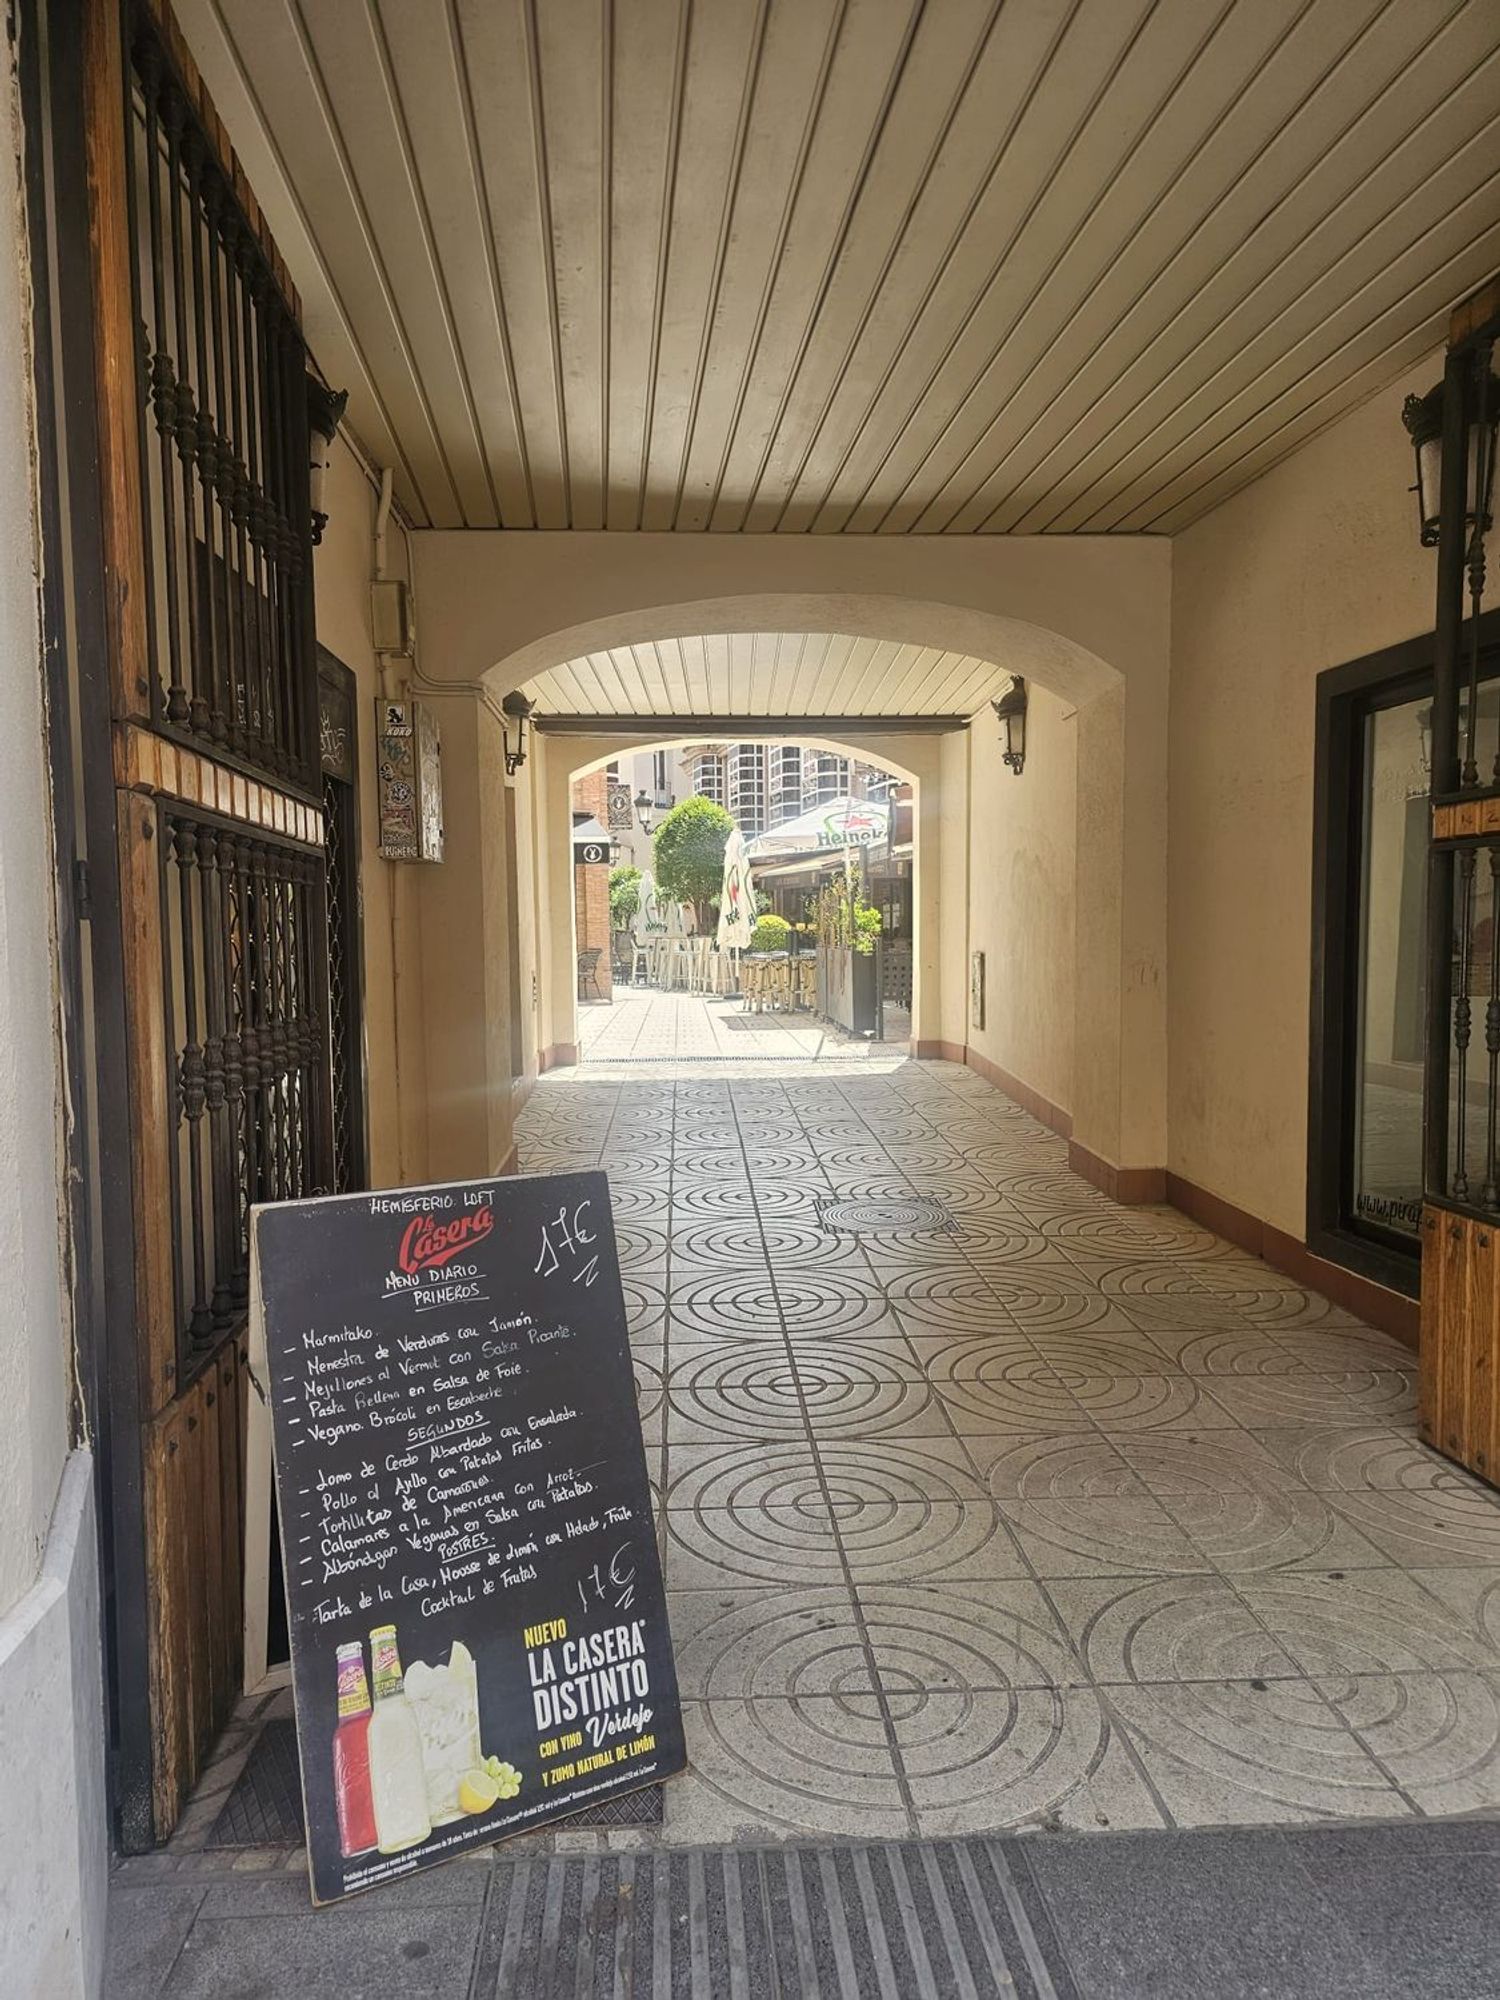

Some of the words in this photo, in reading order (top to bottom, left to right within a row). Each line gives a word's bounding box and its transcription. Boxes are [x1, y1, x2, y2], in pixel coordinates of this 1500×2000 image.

[370, 1195, 453, 1215] HEMISFERIO
[464, 1190, 495, 1206] LOFT
[399, 1205, 495, 1274] Casera
[414, 1283, 480, 1305] PRIMEROS
[429, 1265, 477, 1282] DIARIO
[304, 1377, 373, 1400] Mejillones
[378, 1365, 390, 1380] al
[449, 1352, 471, 1364] con
[482, 1341, 519, 1359] Salsa
[307, 1349, 365, 1376] Menestra
[375, 1344, 390, 1360] de
[397, 1332, 449, 1352] Verduras
[309, 1399, 346, 1418] Pasta
[409, 1386, 425, 1397] en
[433, 1376, 469, 1392] Salsa
[476, 1369, 490, 1382] de
[369, 1407, 417, 1427] Brócoli
[426, 1403, 441, 1415] en
[408, 1410, 483, 1441] SEGUNDOS
[316, 1469, 352, 1491] Lomo
[360, 1461, 375, 1478] de
[385, 1453, 419, 1471] Cerdo
[430, 1432, 492, 1463] Albardado
[322, 1492, 357, 1512] Pollo
[367, 1482, 379, 1500] al
[395, 1473, 427, 1496] Ajillo
[460, 1450, 502, 1471] Patatas
[321, 1528, 391, 1556] Calamares
[399, 1523, 409, 1532] a
[413, 1512, 431, 1530] la
[443, 1491, 505, 1524] Americana
[514, 1483, 534, 1495] con
[402, 1495, 418, 1512] de
[322, 1546, 398, 1584] Albóndigas
[406, 1525, 459, 1552] Veganas
[464, 1520, 479, 1532] en
[485, 1507, 519, 1524] Salsa
[359, 1591, 373, 1609] de
[378, 1585, 393, 1602] la
[439, 1562, 480, 1586] Mousse
[488, 1552, 501, 1566] de
[421, 1586, 476, 1617] Cocktail
[482, 1579, 495, 1595] de
[500, 1564, 537, 1588] Frutas
[577, 1541, 637, 1613] 17€
[524, 1618, 567, 1649] NUEVO
[527, 1648, 557, 1687] LA
[533, 1658, 649, 1731] DISTINTO
[539, 1738, 558, 1758] CON
[561, 1731, 583, 1751] VINO
[585, 1703, 653, 1748] Verdejo
[541, 1771, 549, 1787] Y
[551, 1763, 575, 1785] ZUMO
[577, 1749, 615, 1776] NATURAL
[616, 1744, 627, 1762] DE
[629, 1734, 656, 1759] LIMÓN
